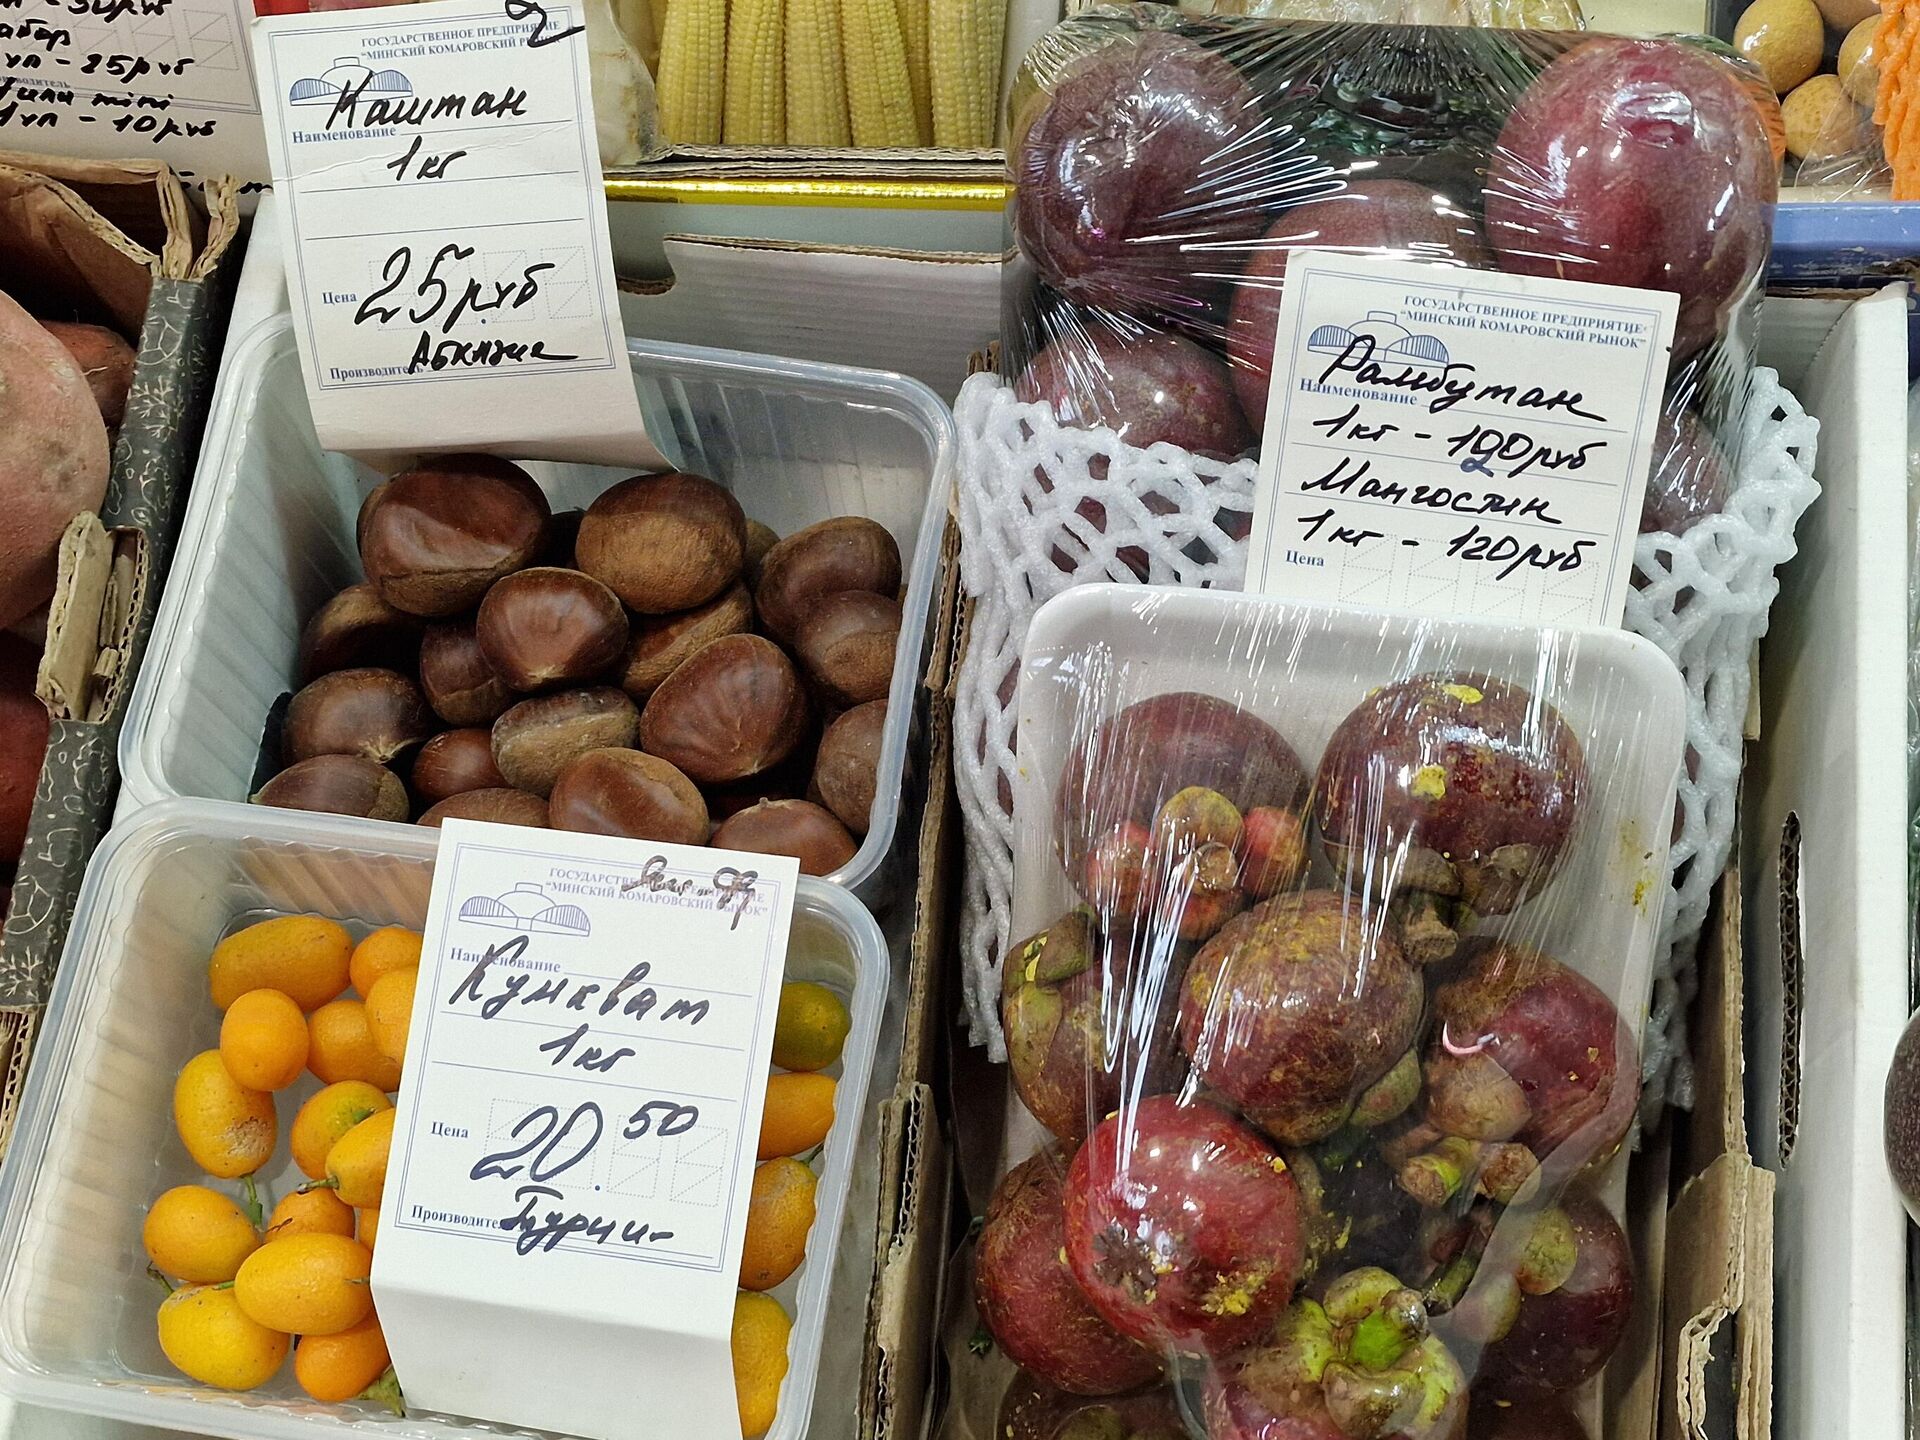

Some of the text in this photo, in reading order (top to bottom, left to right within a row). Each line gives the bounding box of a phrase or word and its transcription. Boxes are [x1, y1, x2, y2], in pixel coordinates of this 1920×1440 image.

[0, 18, 71, 51] абор
[361, 20, 561, 48] ГОСУДАРСТВЕННОЕ ПРЕДПРИЯИЕ
[428, 37, 517, 56] КОМАРОВСКИЙ
[326, 70, 527, 129] Каштан
[112, 114, 216, 143] 10руб
[292, 125, 397, 144] Наименование
[322, 291, 357, 304] Цена
[1403, 295, 1645, 334] ГОСУДАРСТВЕННОЕ ПРЕДПРИЯТИЕ
[1479, 319, 1585, 342] КОМАРОВСКИЙ
[329, 364, 423, 380] Производитеь
[1318, 335, 1607, 422] Рамбутан
[1299, 378, 1418, 405] Наименование
[1301, 457, 1563, 524] Мангостин
[1285, 549, 1325, 567] Цена
[1446, 525, 1596, 581] 120руб
[618, 891, 718, 910] КОМАРОВСКИЙ
[448, 935, 710, 1025] Кумкват
[430, 1121, 469, 1138] Цена
[470, 1100, 699, 1182] 20 50
[412, 1204, 508, 1231] Производите
